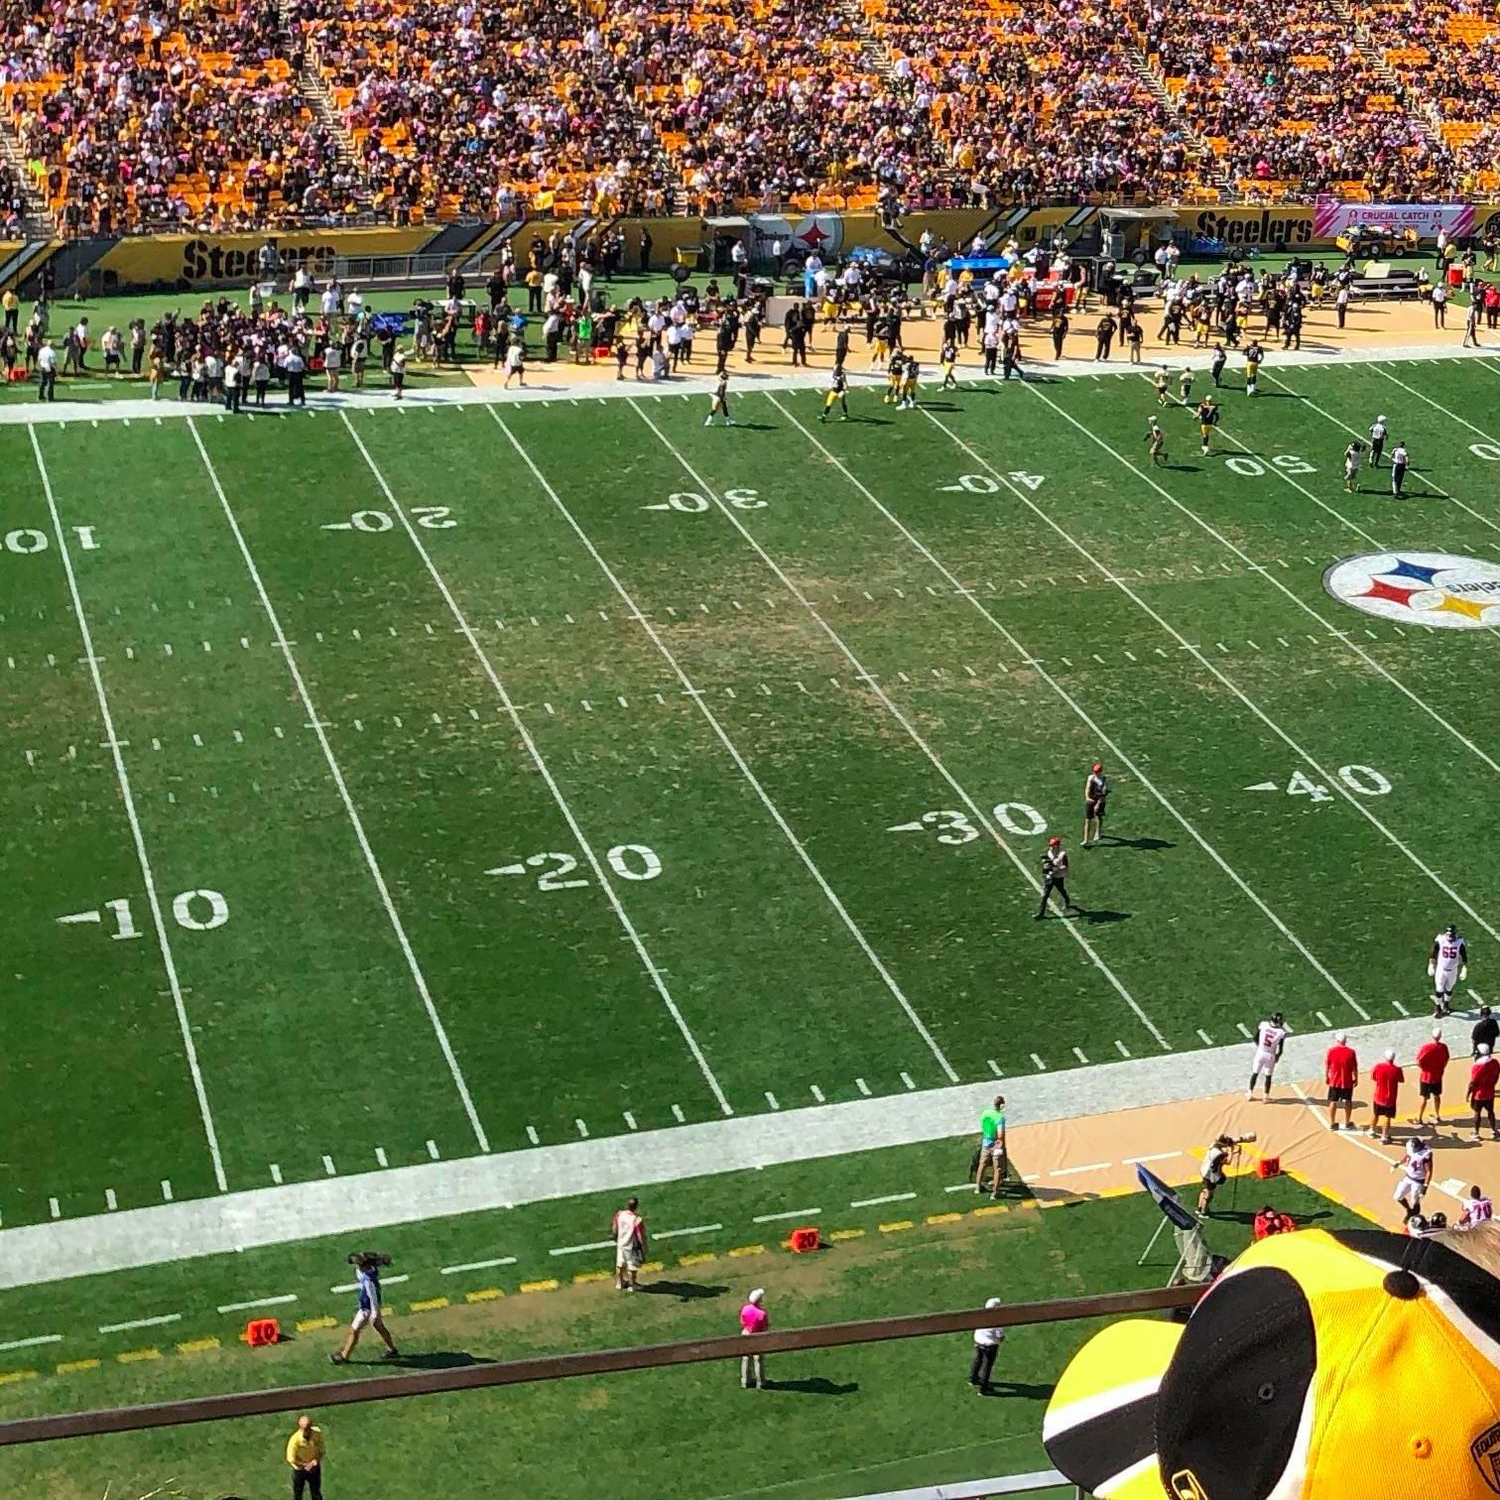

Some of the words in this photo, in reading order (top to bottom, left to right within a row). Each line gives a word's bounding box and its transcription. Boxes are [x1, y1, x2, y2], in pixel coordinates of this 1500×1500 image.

[1196, 209, 1312, 244] Steelers
[1361, 211, 1400, 220] CRUCIAL
[1402, 211, 1429, 221] CATCH
[1224, 454, 1319, 478] 50
[666, 487, 769, 514] 30
[350, 505, 458, 534] 20
[1285, 764, 1394, 803] 40
[921, 802, 1048, 845] 30
[525, 843, 663, 892] 20
[105, 888, 229, 941] 10
[1441, 946, 1458, 959] 65
[253, 1323, 275, 1343] 10
